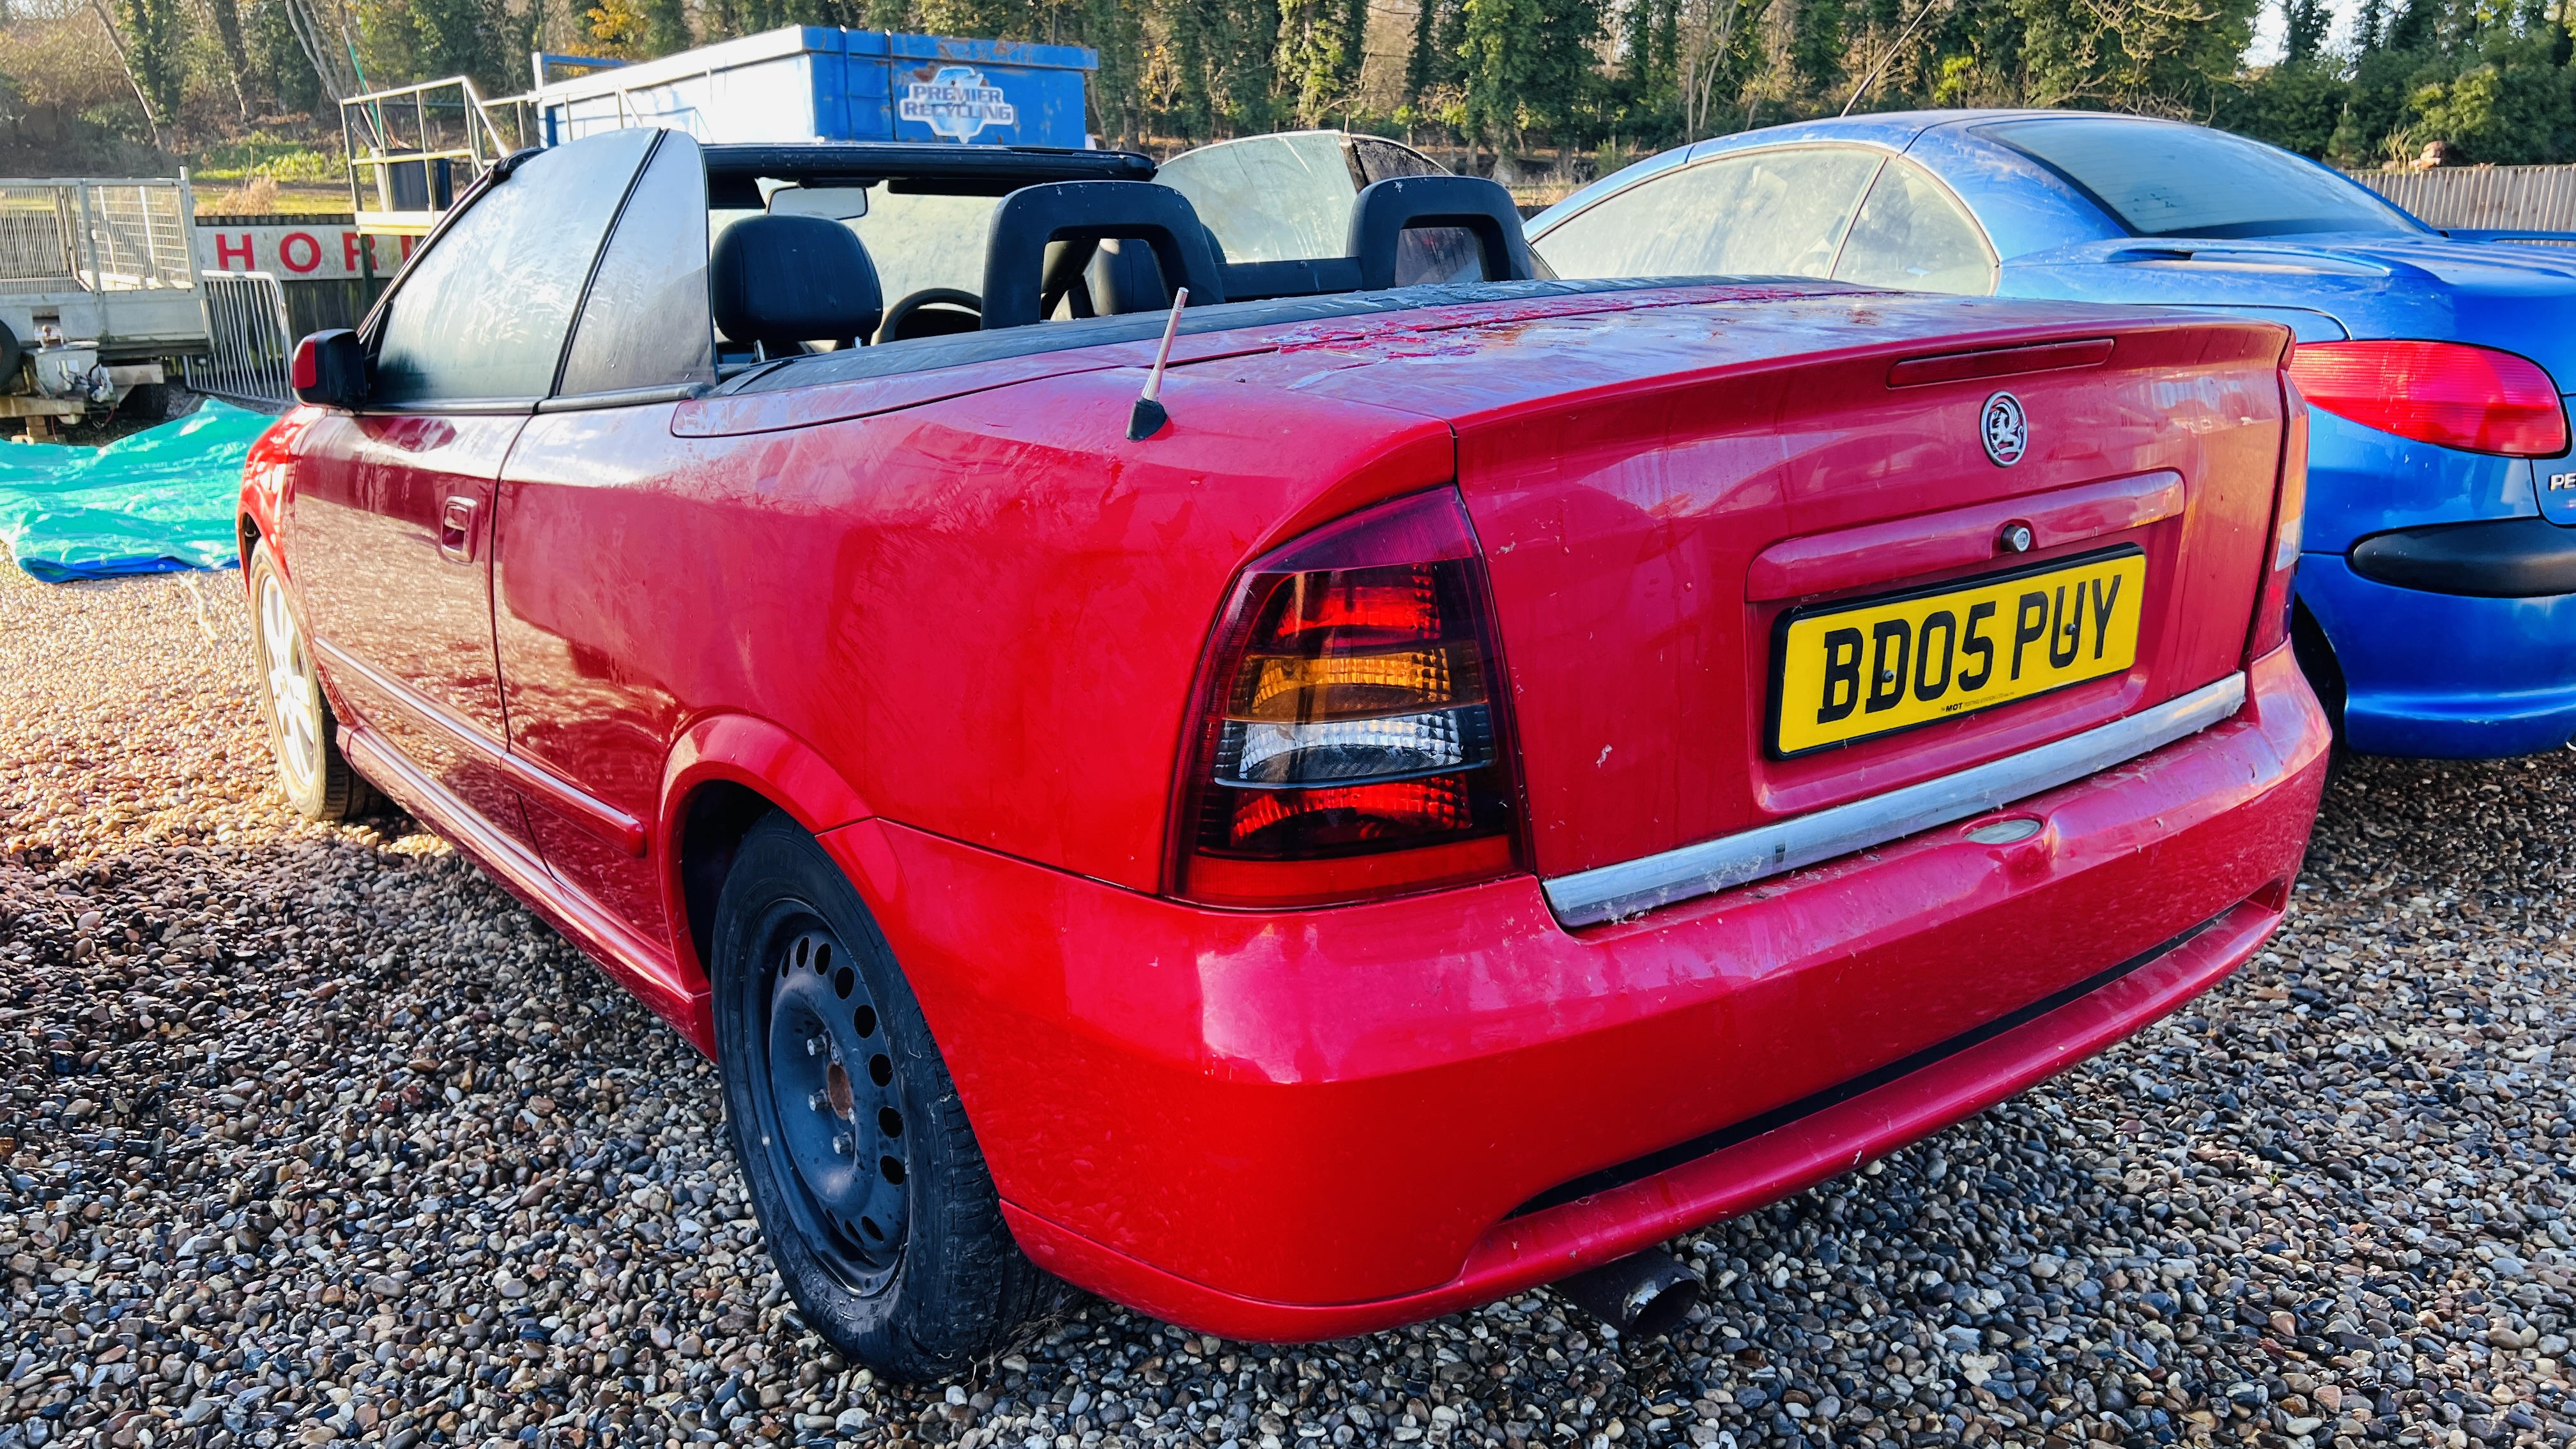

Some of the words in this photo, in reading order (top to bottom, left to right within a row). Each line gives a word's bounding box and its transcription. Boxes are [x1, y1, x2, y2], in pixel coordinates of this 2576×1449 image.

[914, 86, 1001, 103] PREMIER
[905, 102, 1011, 119] RECYCLING
[1816, 601, 1996, 725] BD05
[2010, 574, 2121, 680] PUY
[1945, 703, 1963, 712] MOT
